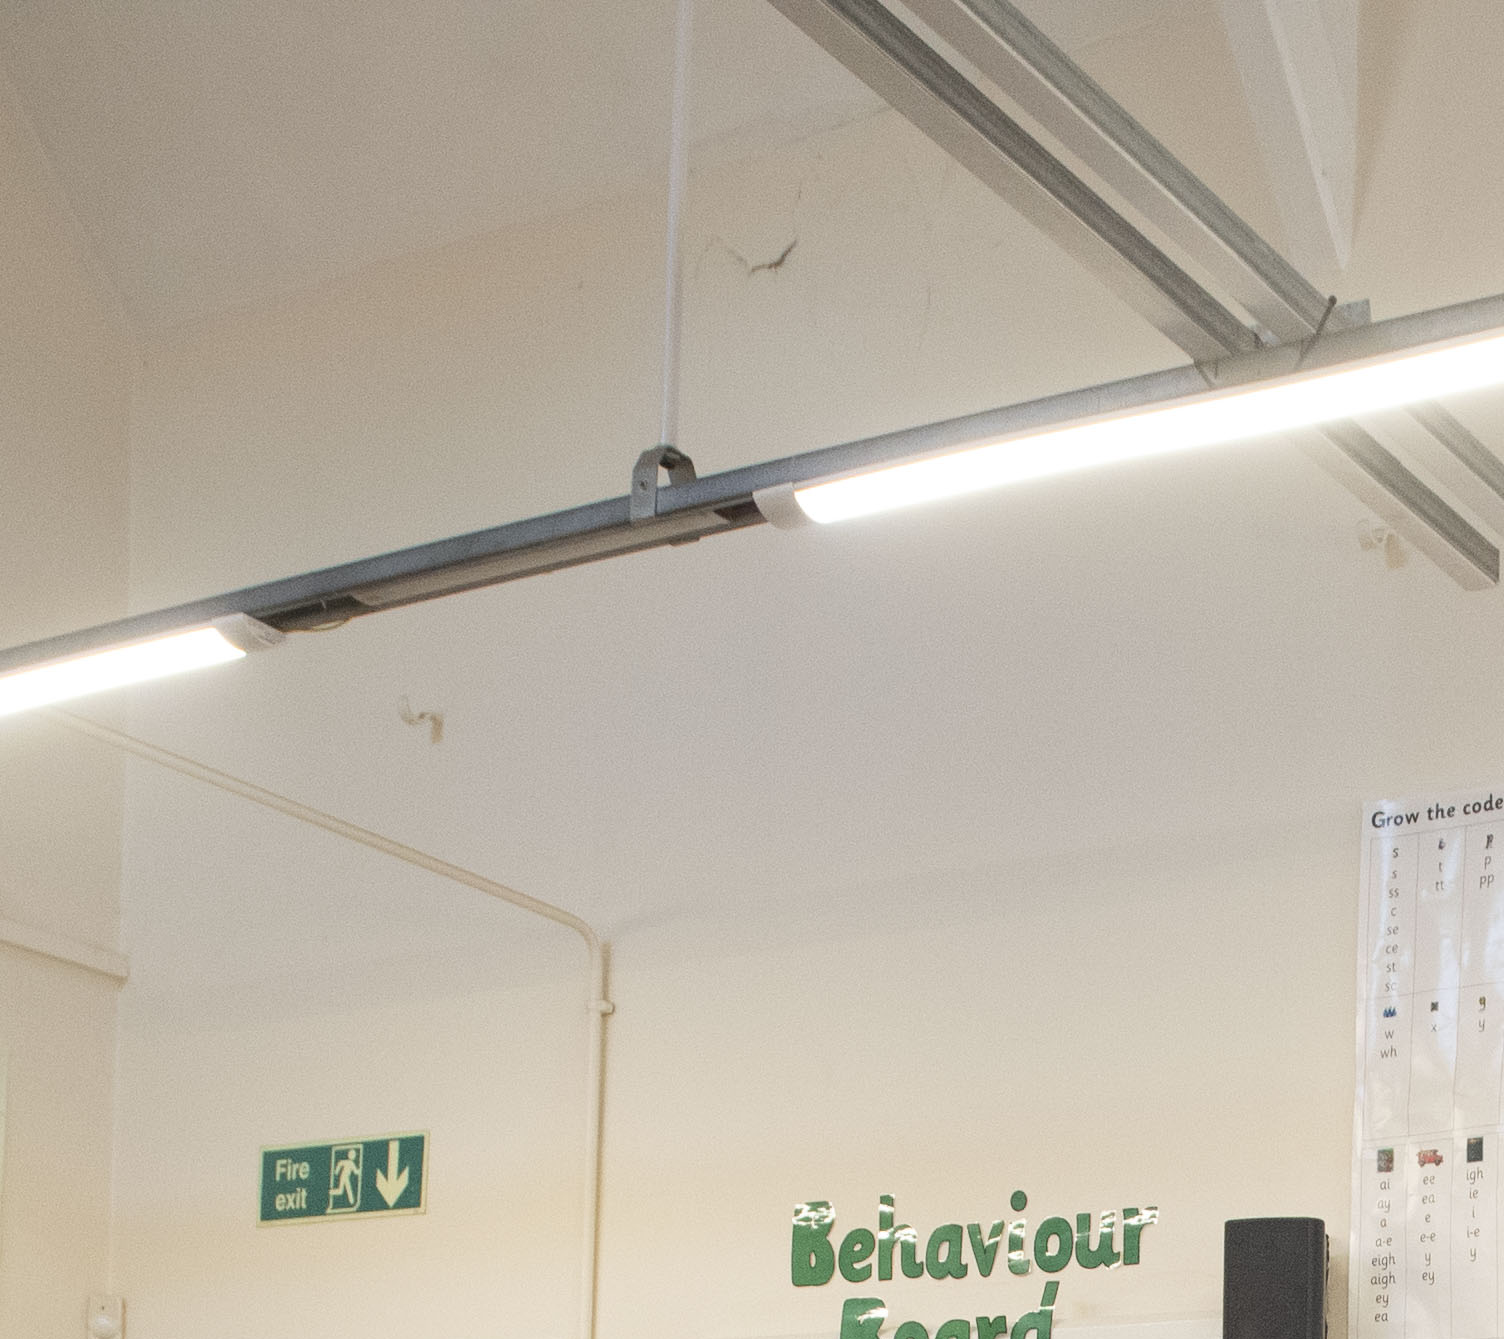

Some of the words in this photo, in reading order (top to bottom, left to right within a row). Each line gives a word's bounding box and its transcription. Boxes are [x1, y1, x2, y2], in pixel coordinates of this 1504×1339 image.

[1371, 810, 1419, 828] Grow
[1427, 804, 1455, 821] the
[1463, 794, 1503, 815] code
[275, 1158, 310, 1181] Fire
[275, 1188, 307, 1211] exit
[791, 1191, 1158, 1286] Behaviour
